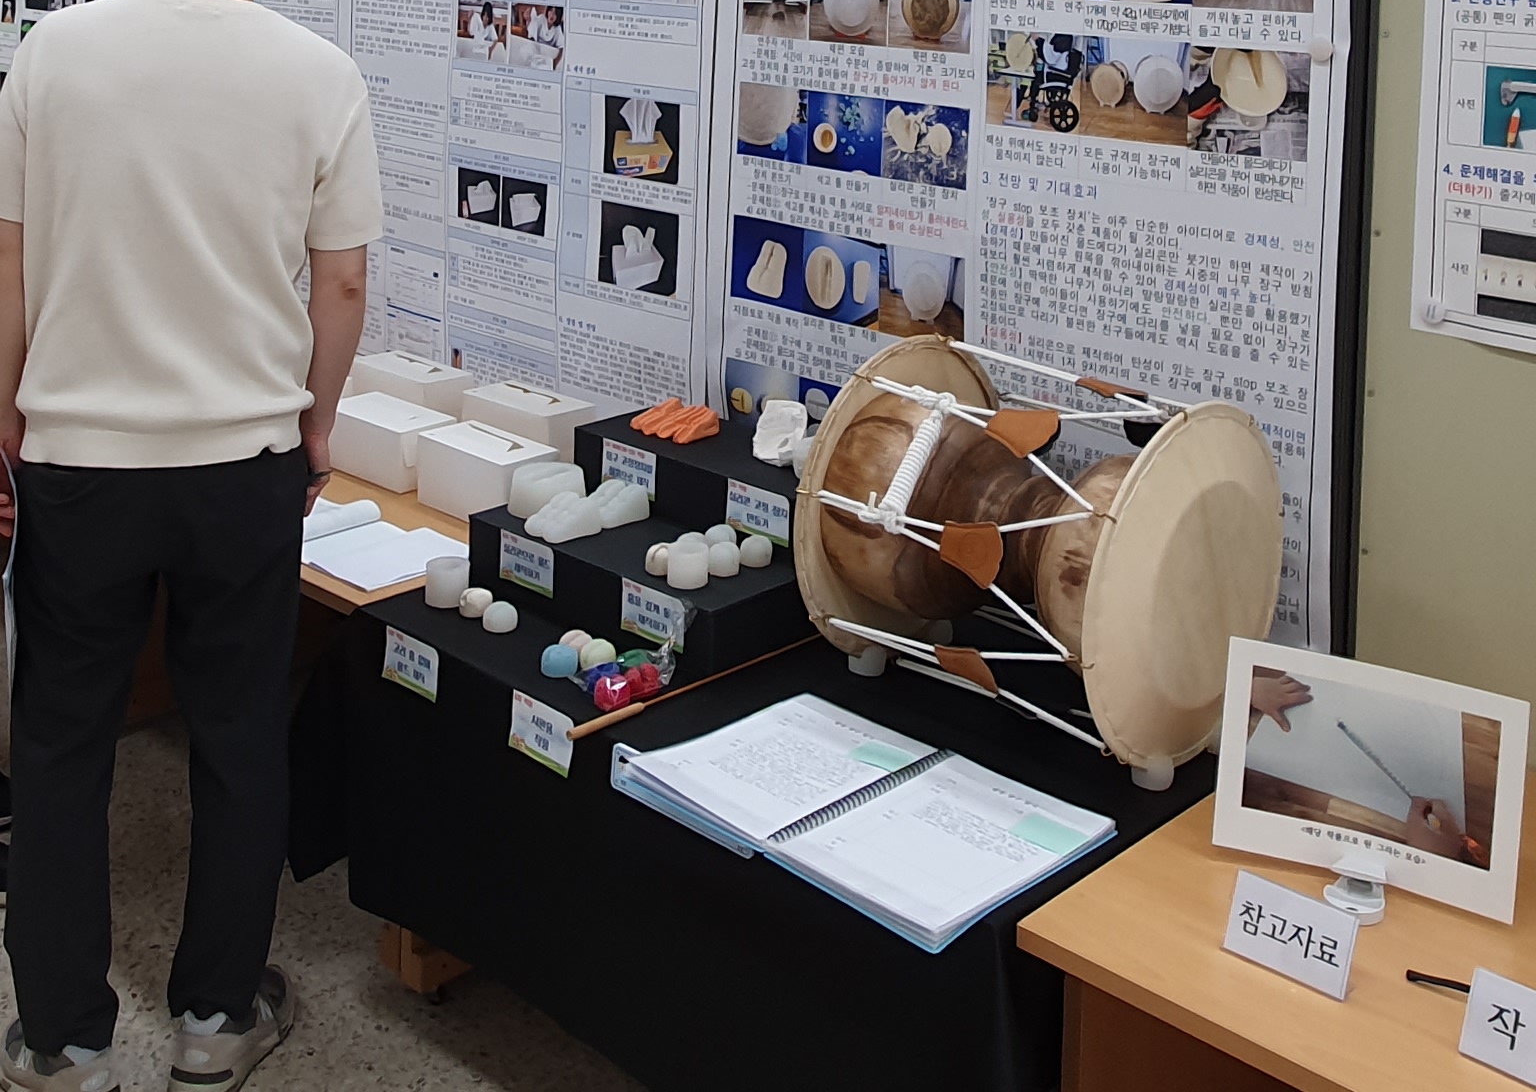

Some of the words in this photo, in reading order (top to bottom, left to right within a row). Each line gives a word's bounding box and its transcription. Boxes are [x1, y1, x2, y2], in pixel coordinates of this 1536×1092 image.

[1442, 163, 1454, 176] 4.
[1459, 163, 1526, 186] 문제해결을
[1447, 181, 1493, 200] (더하기)
[1499, 188, 1536, 206] 줄자에
[1238, 899, 1340, 970] 참고자료
[1487, 1002, 1527, 1052] 작
